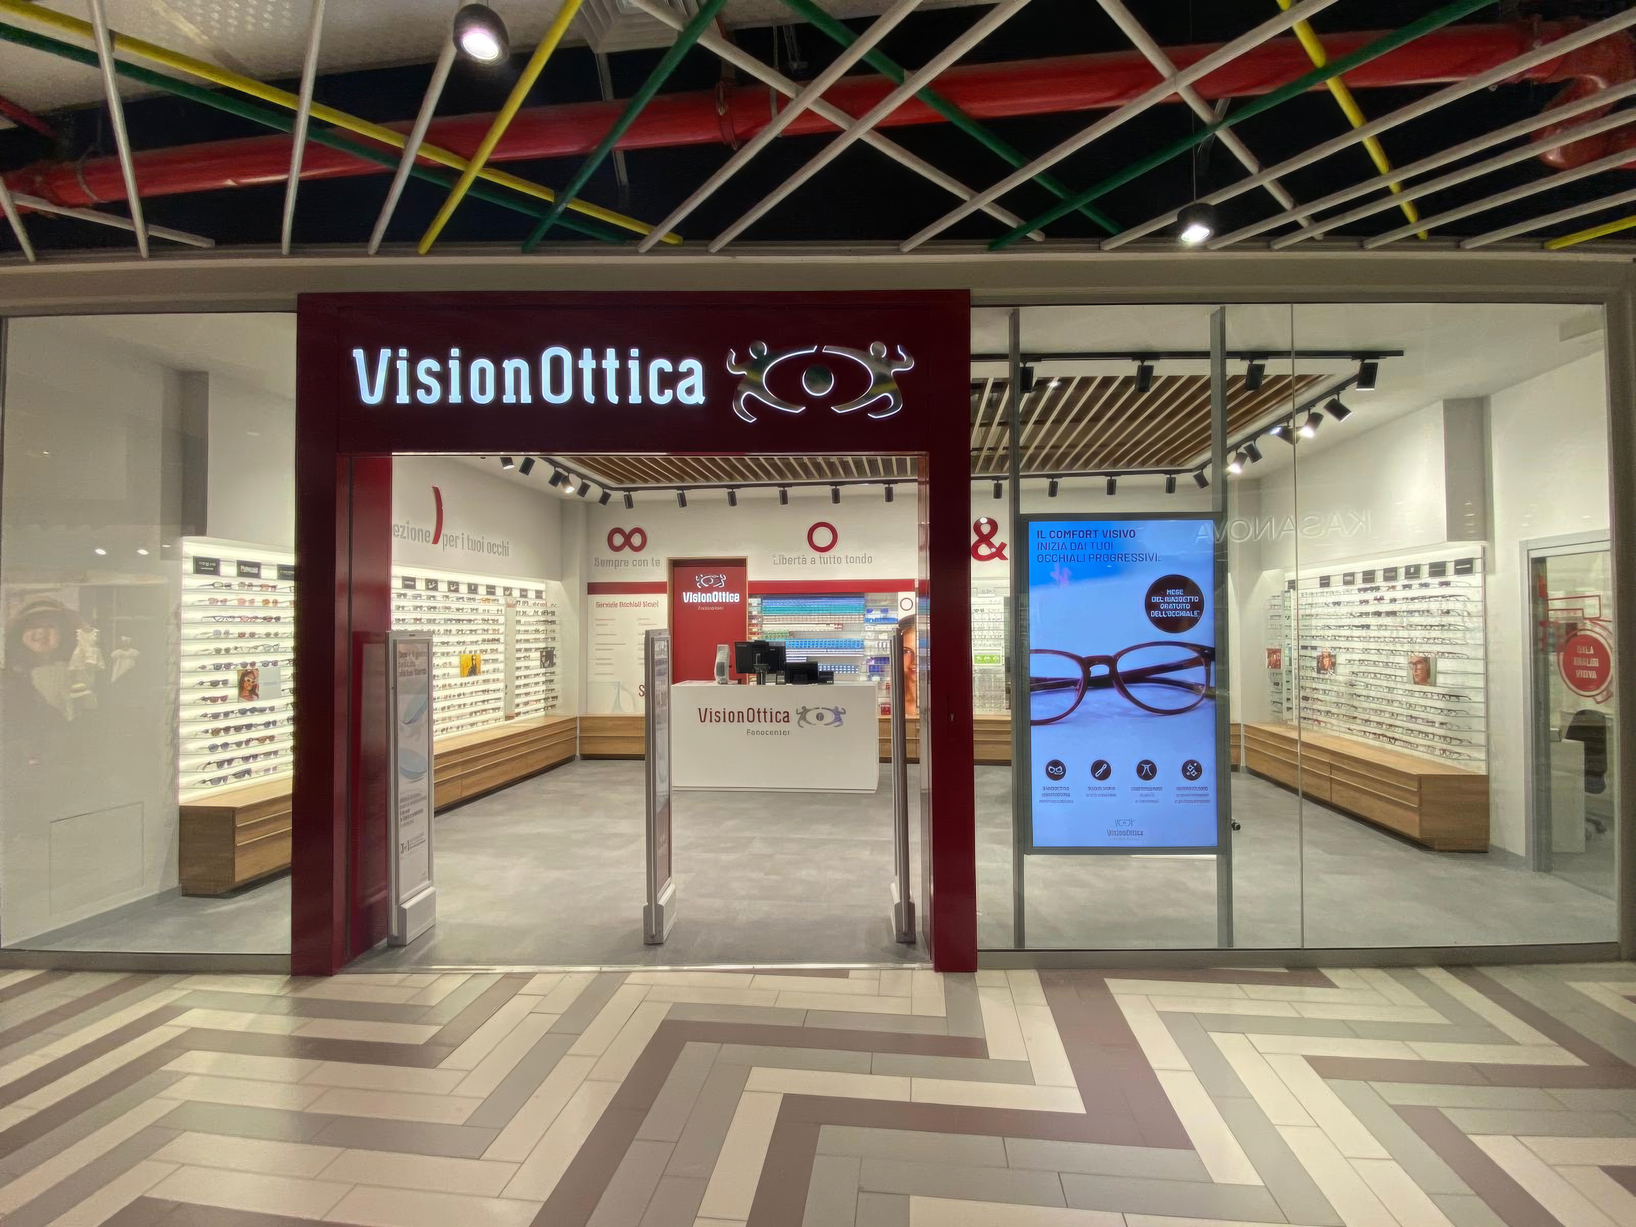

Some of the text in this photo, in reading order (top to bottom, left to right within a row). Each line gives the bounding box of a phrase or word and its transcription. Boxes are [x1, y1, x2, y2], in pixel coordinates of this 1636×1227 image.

[351, 345, 707, 406] VisionOttica
[1036, 529, 1136, 539] IL COMFORT VISIVO
[486, 541, 510, 557] occhi
[1036, 541, 1068, 551] INIZIA
[632, 558, 649, 567] con
[818, 554, 842, 565] tutto
[845, 552, 873, 565] tondo
[1036, 553, 1086, 563] OCCHIALI
[682, 591, 740, 604] VisionOttica
[698, 707, 791, 724] VisionOttica
